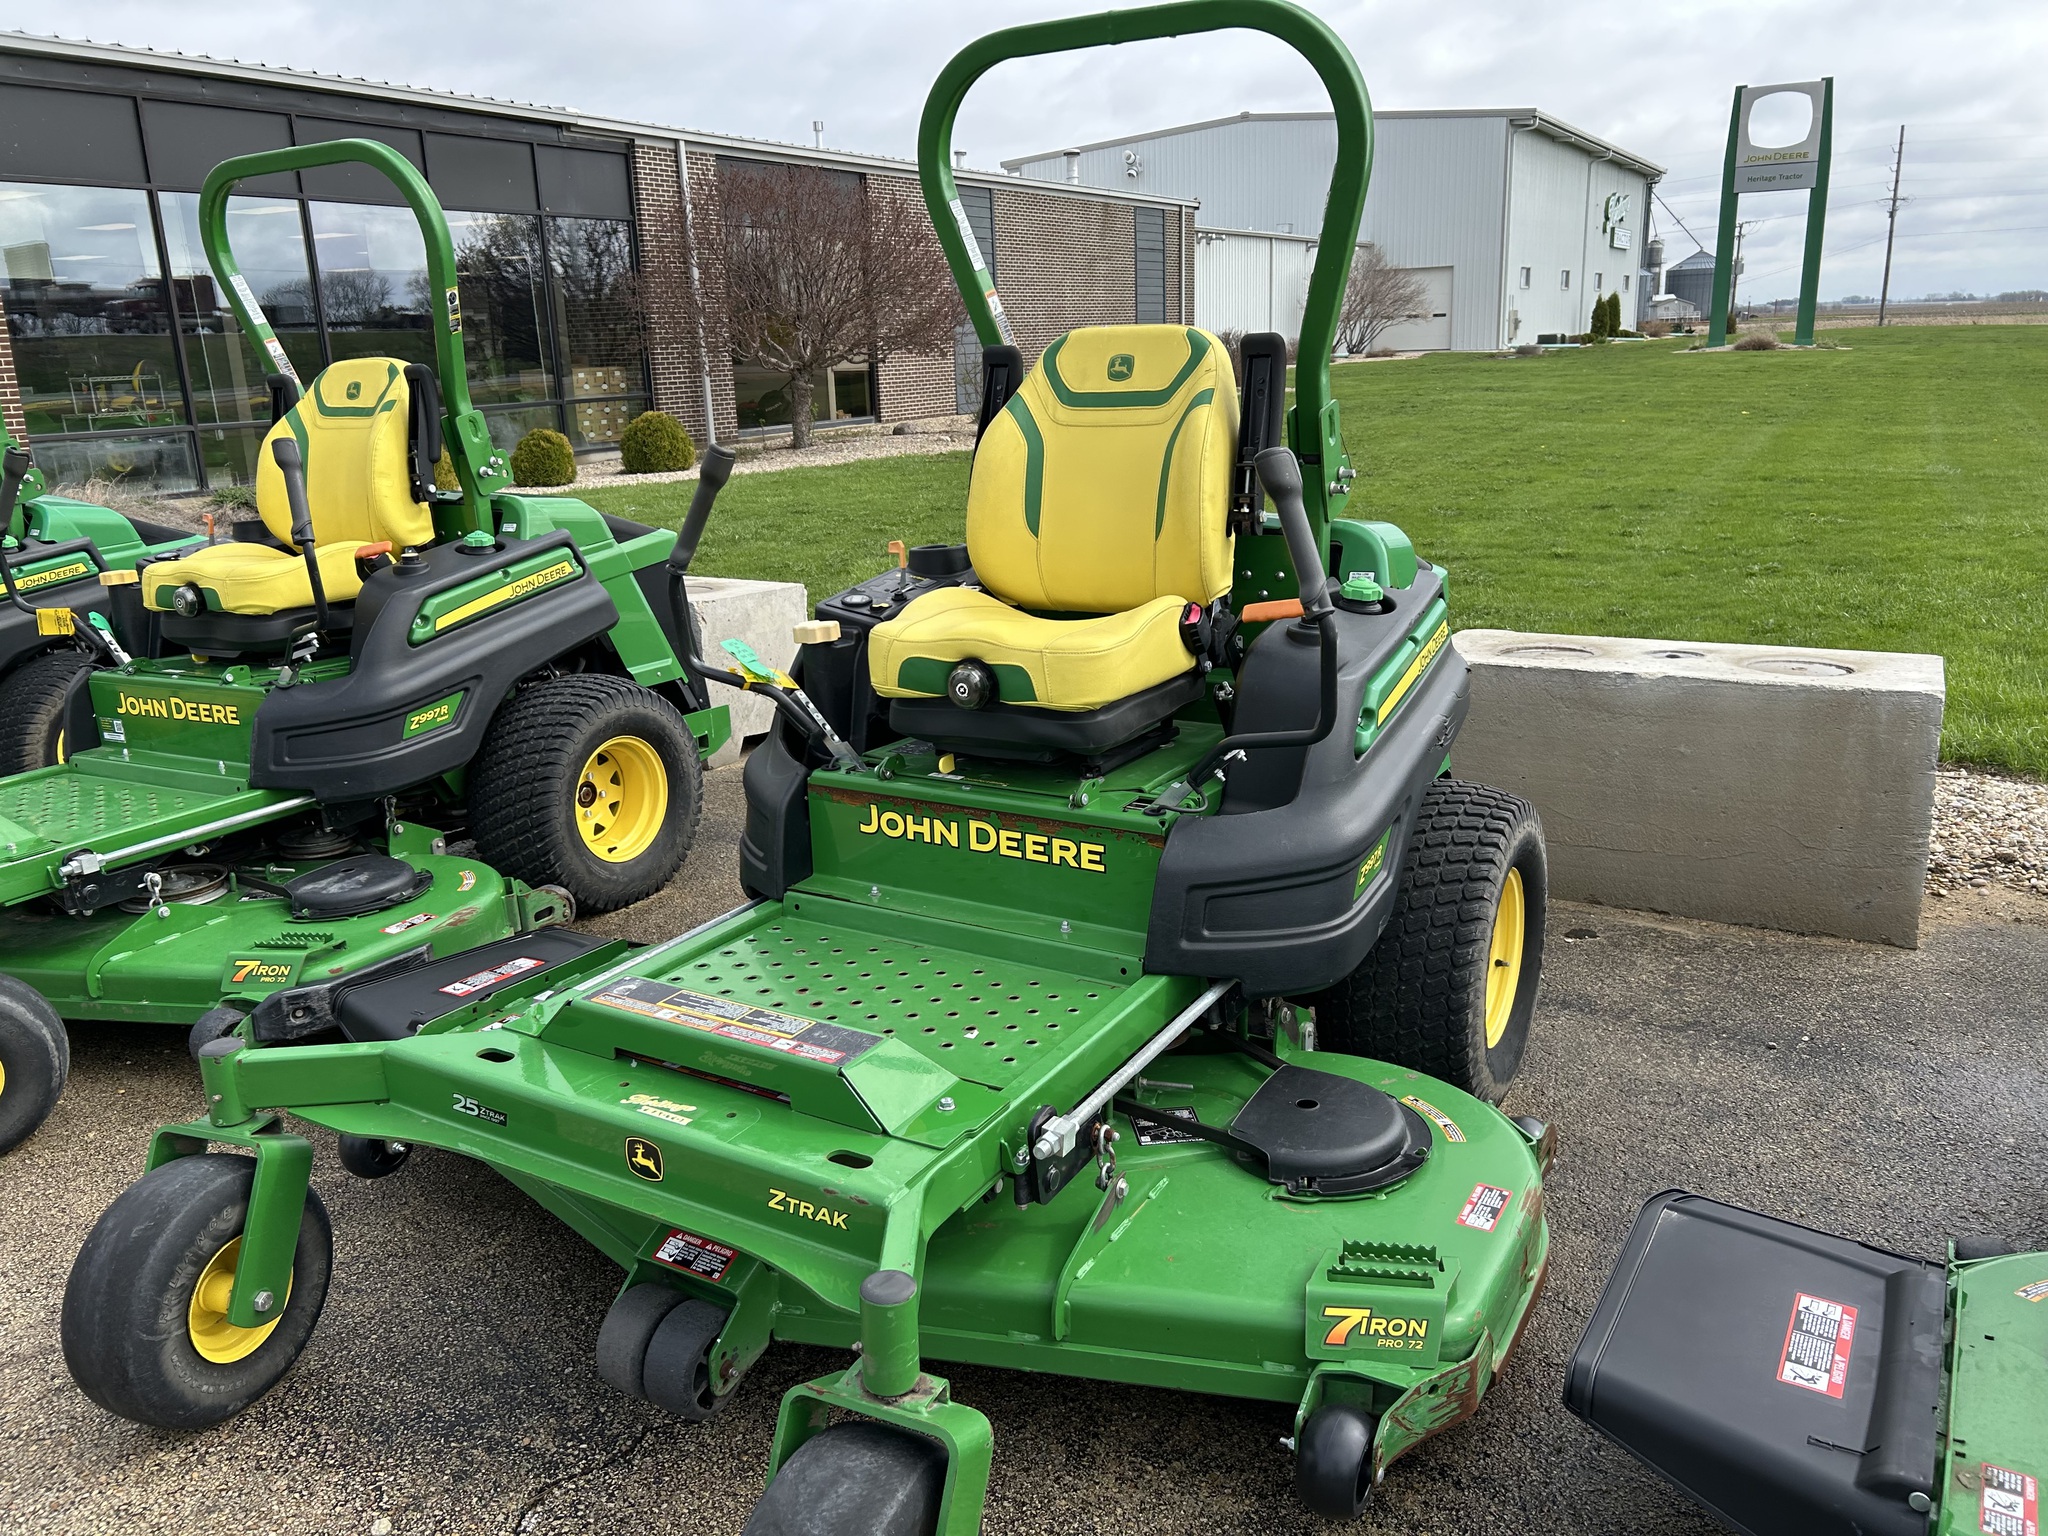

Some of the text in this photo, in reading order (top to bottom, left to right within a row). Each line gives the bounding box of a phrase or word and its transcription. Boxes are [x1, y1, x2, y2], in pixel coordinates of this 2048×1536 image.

[1744, 151, 1810, 163] JOHN DEERE
[1747, 173, 1803, 183] Heritage Tractor
[20, 566, 81, 589] JOHN DEERE
[510, 565, 568, 597] JOHN DEERE
[1419, 625, 1446, 673] JOHN DEERE
[116, 690, 241, 725] JOHN DEERE
[409, 704, 449, 730] Z997R
[859, 803, 1107, 874] JOHN DEERE
[452, 1093, 506, 1122] 25 ZTRAK
[767, 1188, 850, 1231] ZTRAK
[682, 1234, 733, 1257] DANGER PELIGRO
[1377, 1338, 1424, 1350] PRO 72
